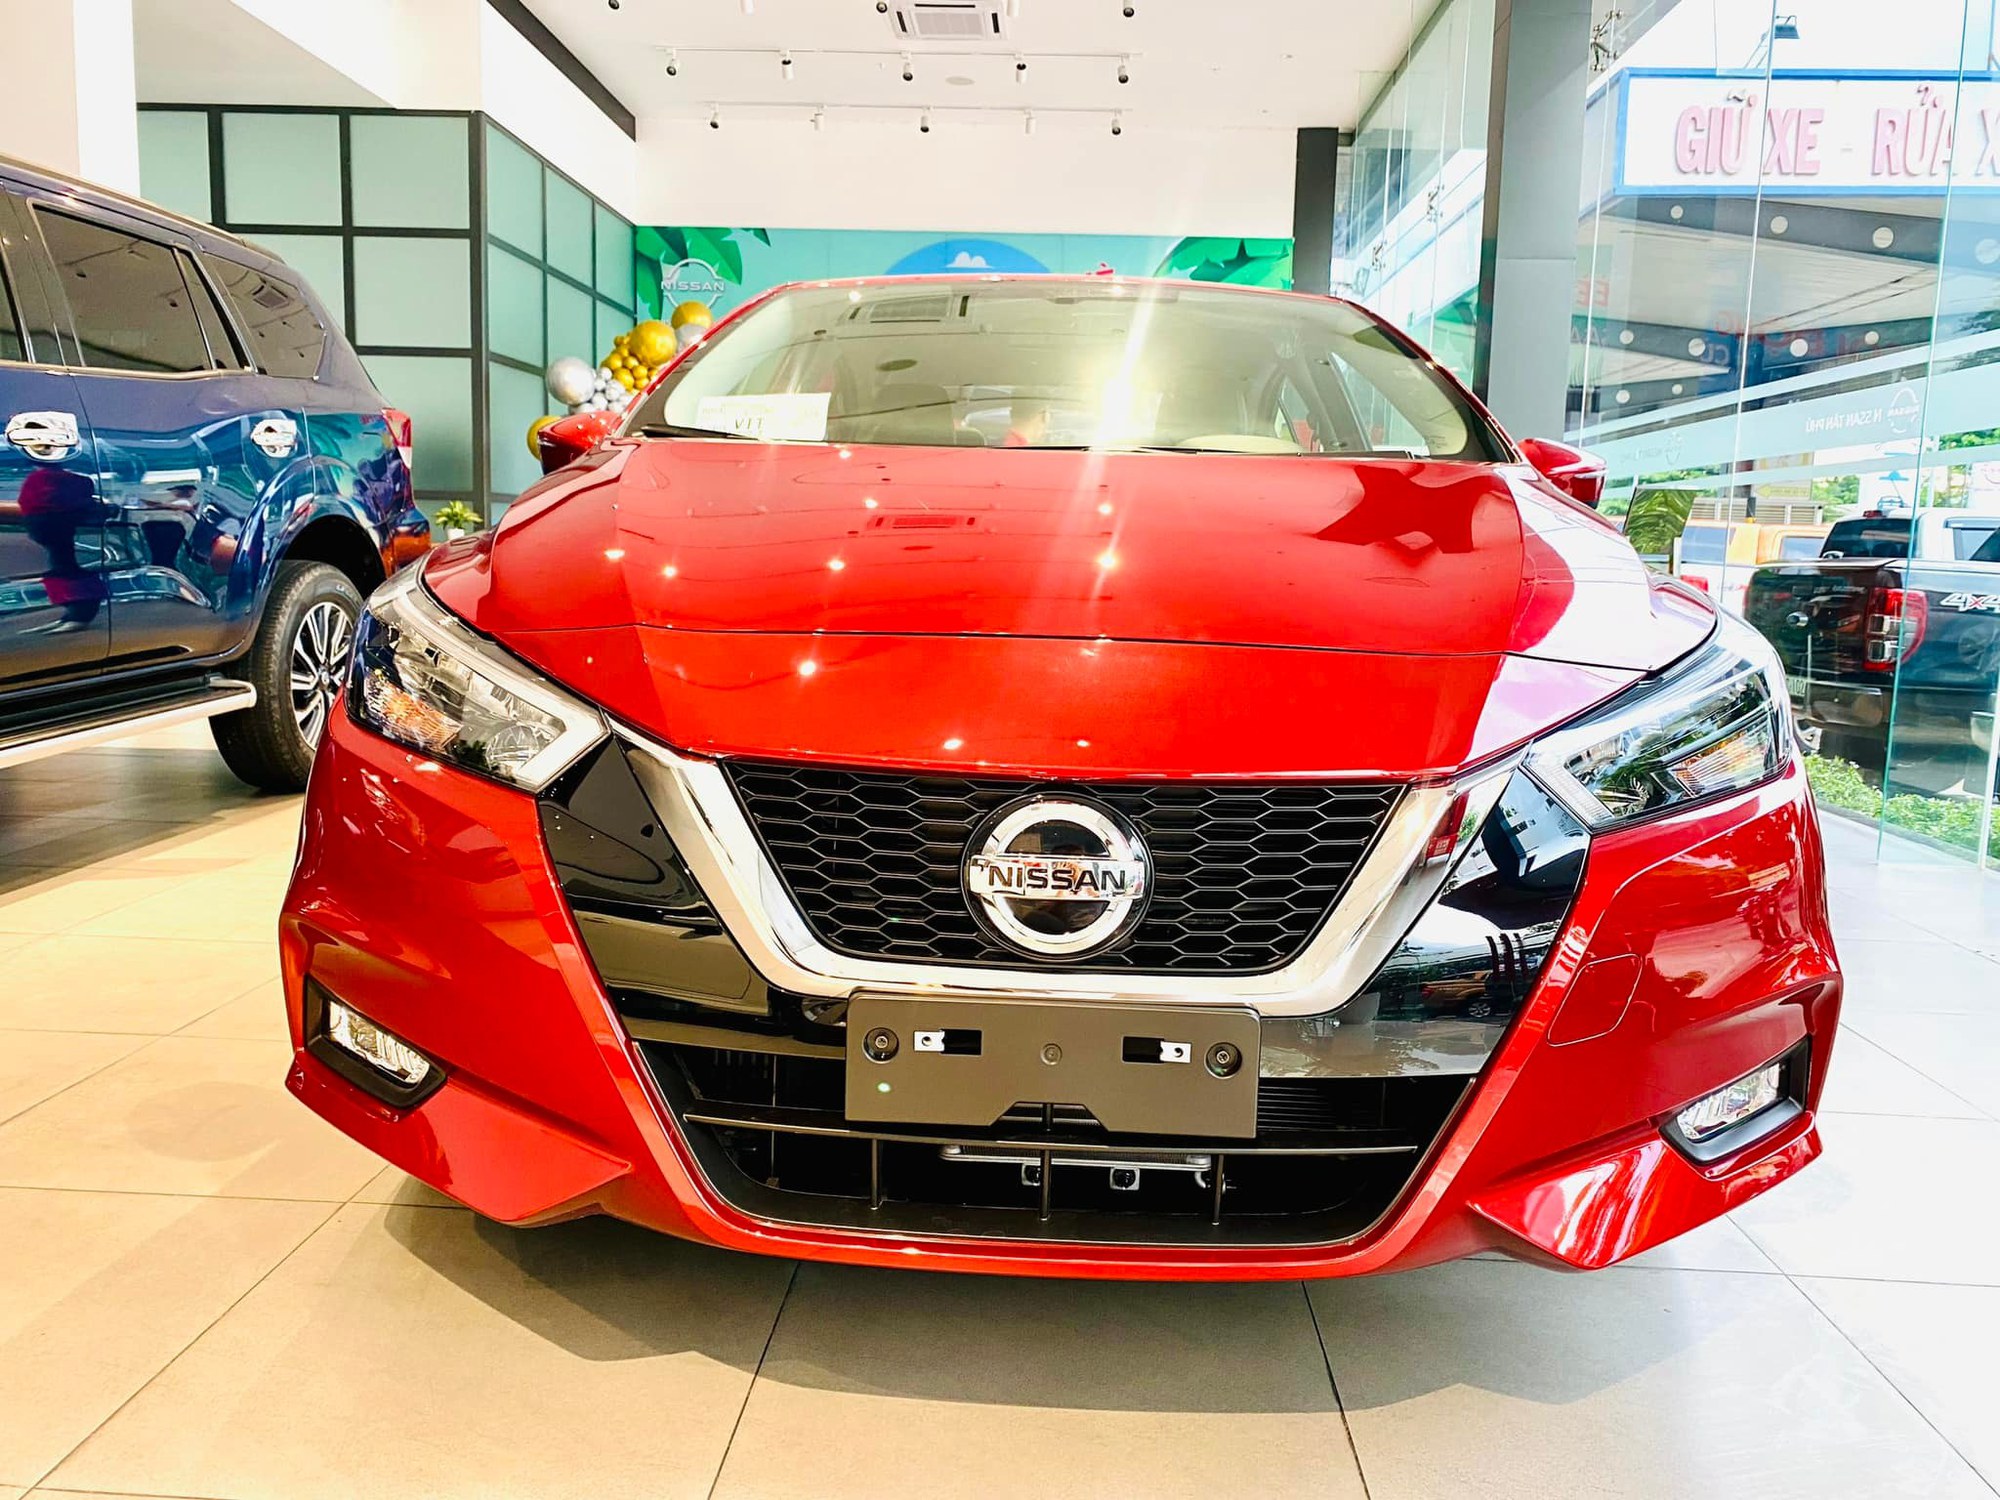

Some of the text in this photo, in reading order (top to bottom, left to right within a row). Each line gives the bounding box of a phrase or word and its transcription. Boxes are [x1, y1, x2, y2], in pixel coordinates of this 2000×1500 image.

[1675, 88, 1757, 176] GIỮ
[1762, 108, 1825, 176] XE
[661, 281, 726, 292] NISSAN
[988, 864, 1126, 891] NISSAN
